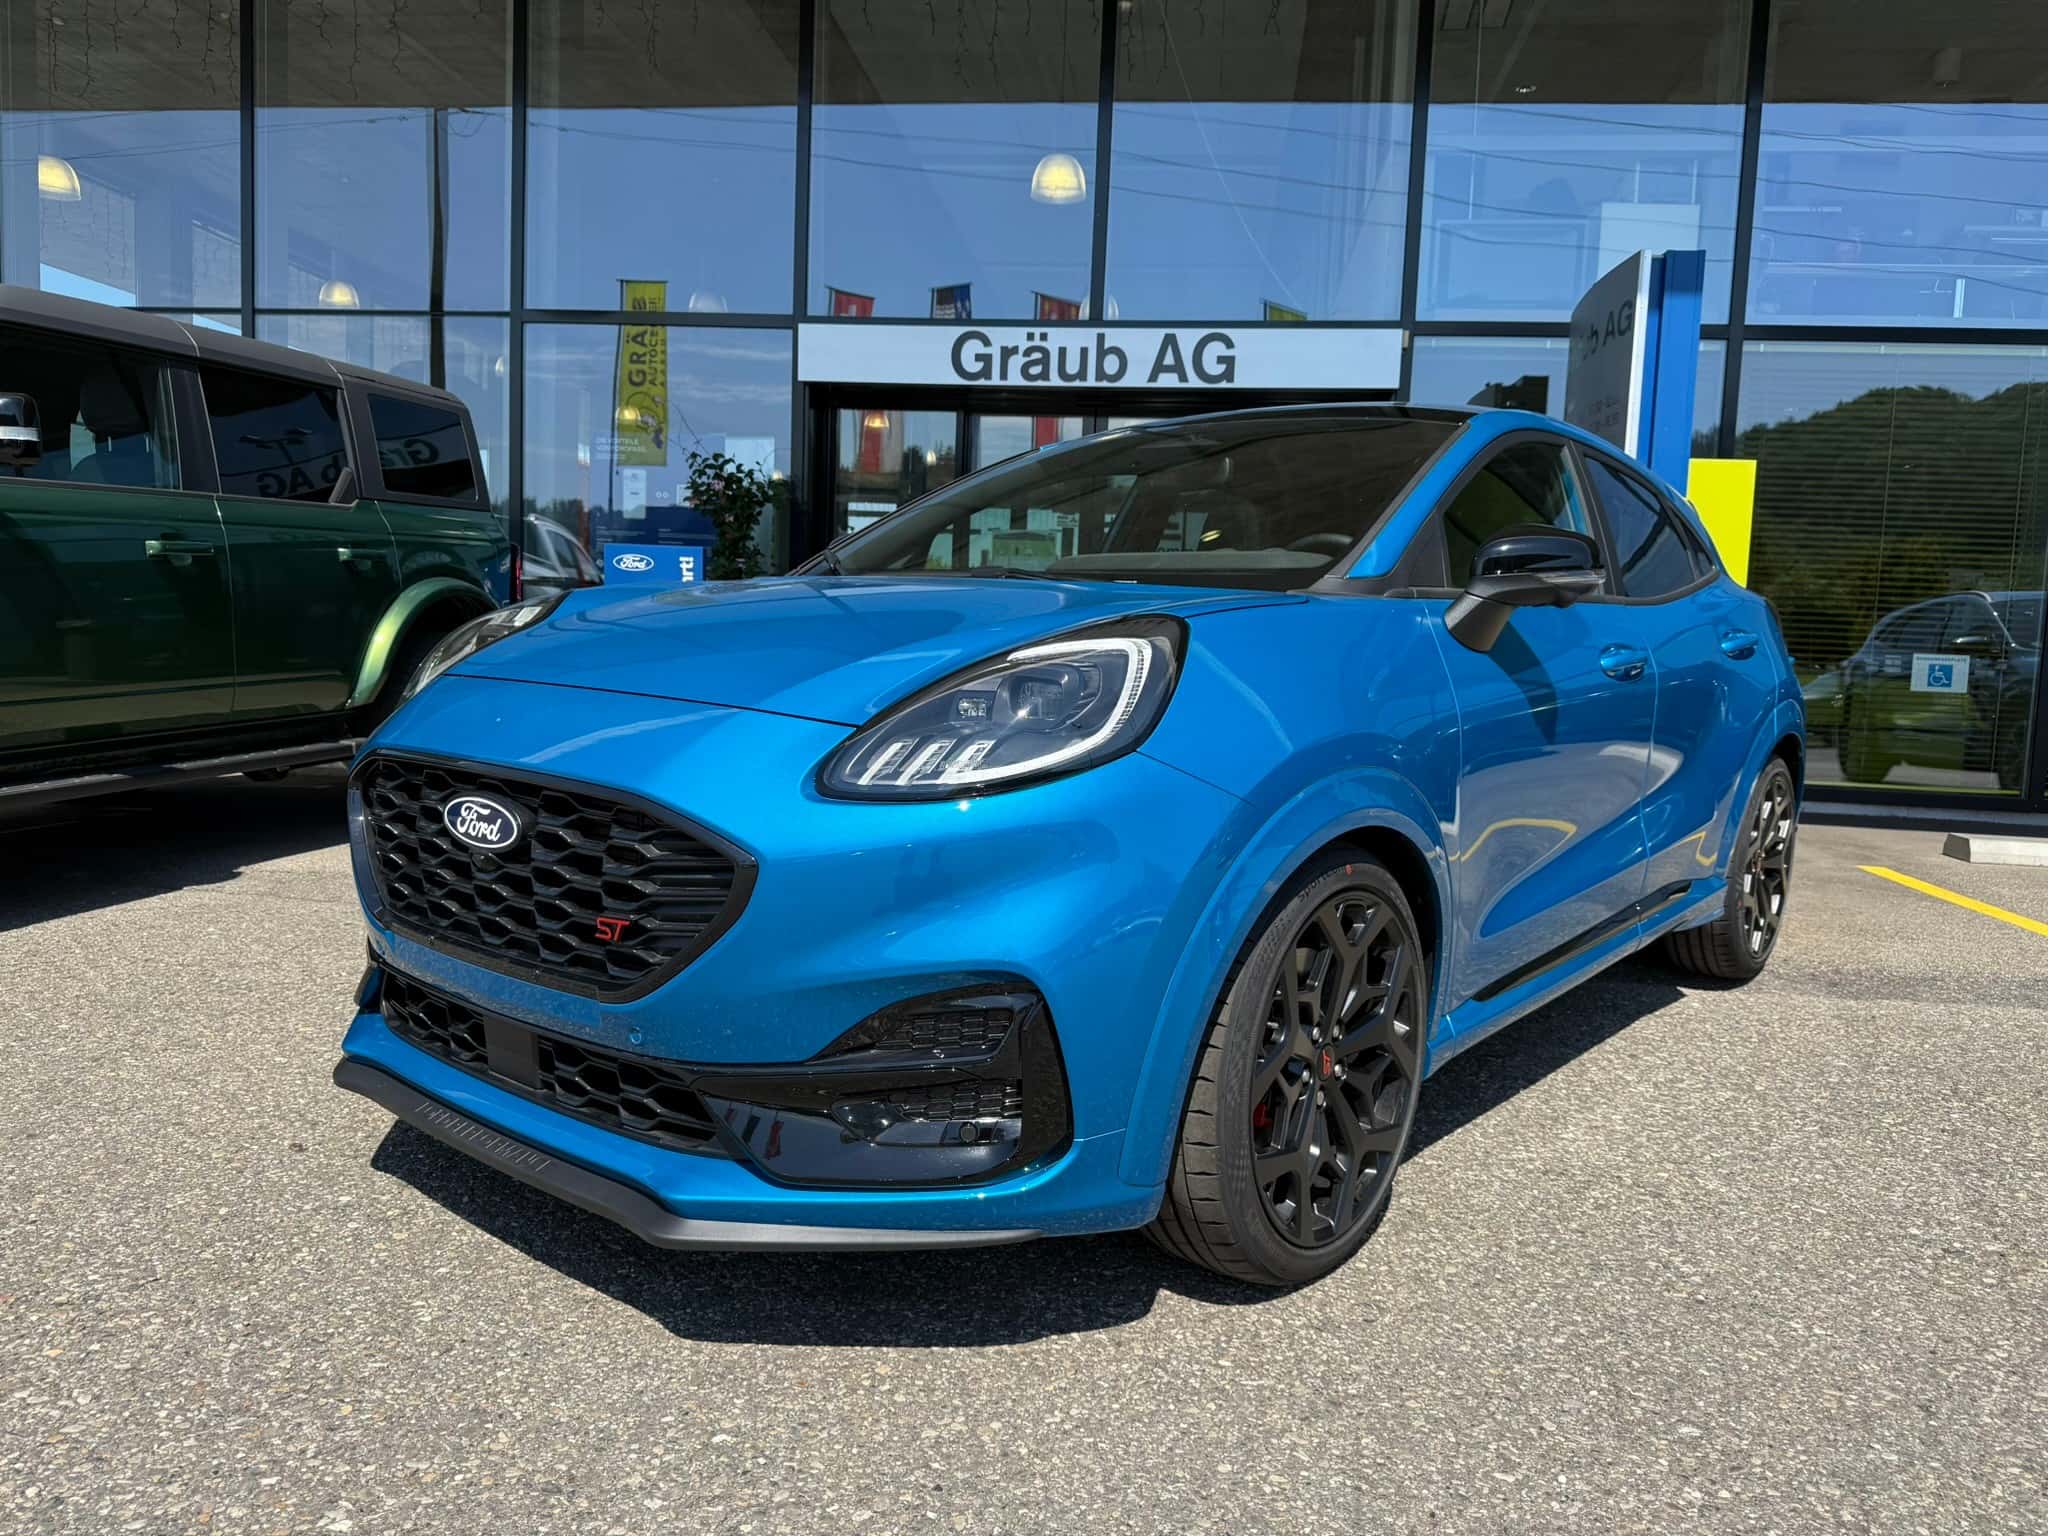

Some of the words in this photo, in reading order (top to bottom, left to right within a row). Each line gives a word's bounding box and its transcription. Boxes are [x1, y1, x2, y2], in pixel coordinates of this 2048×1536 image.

[626, 298, 647, 387] GRÄB
[1602, 299, 1634, 347] AG
[951, 330, 1128, 383] Gräub
[1147, 332, 1236, 384] AG
[618, 555, 648, 569] Ford
[455, 801, 503, 843] Ford
[595, 917, 630, 942] ST
